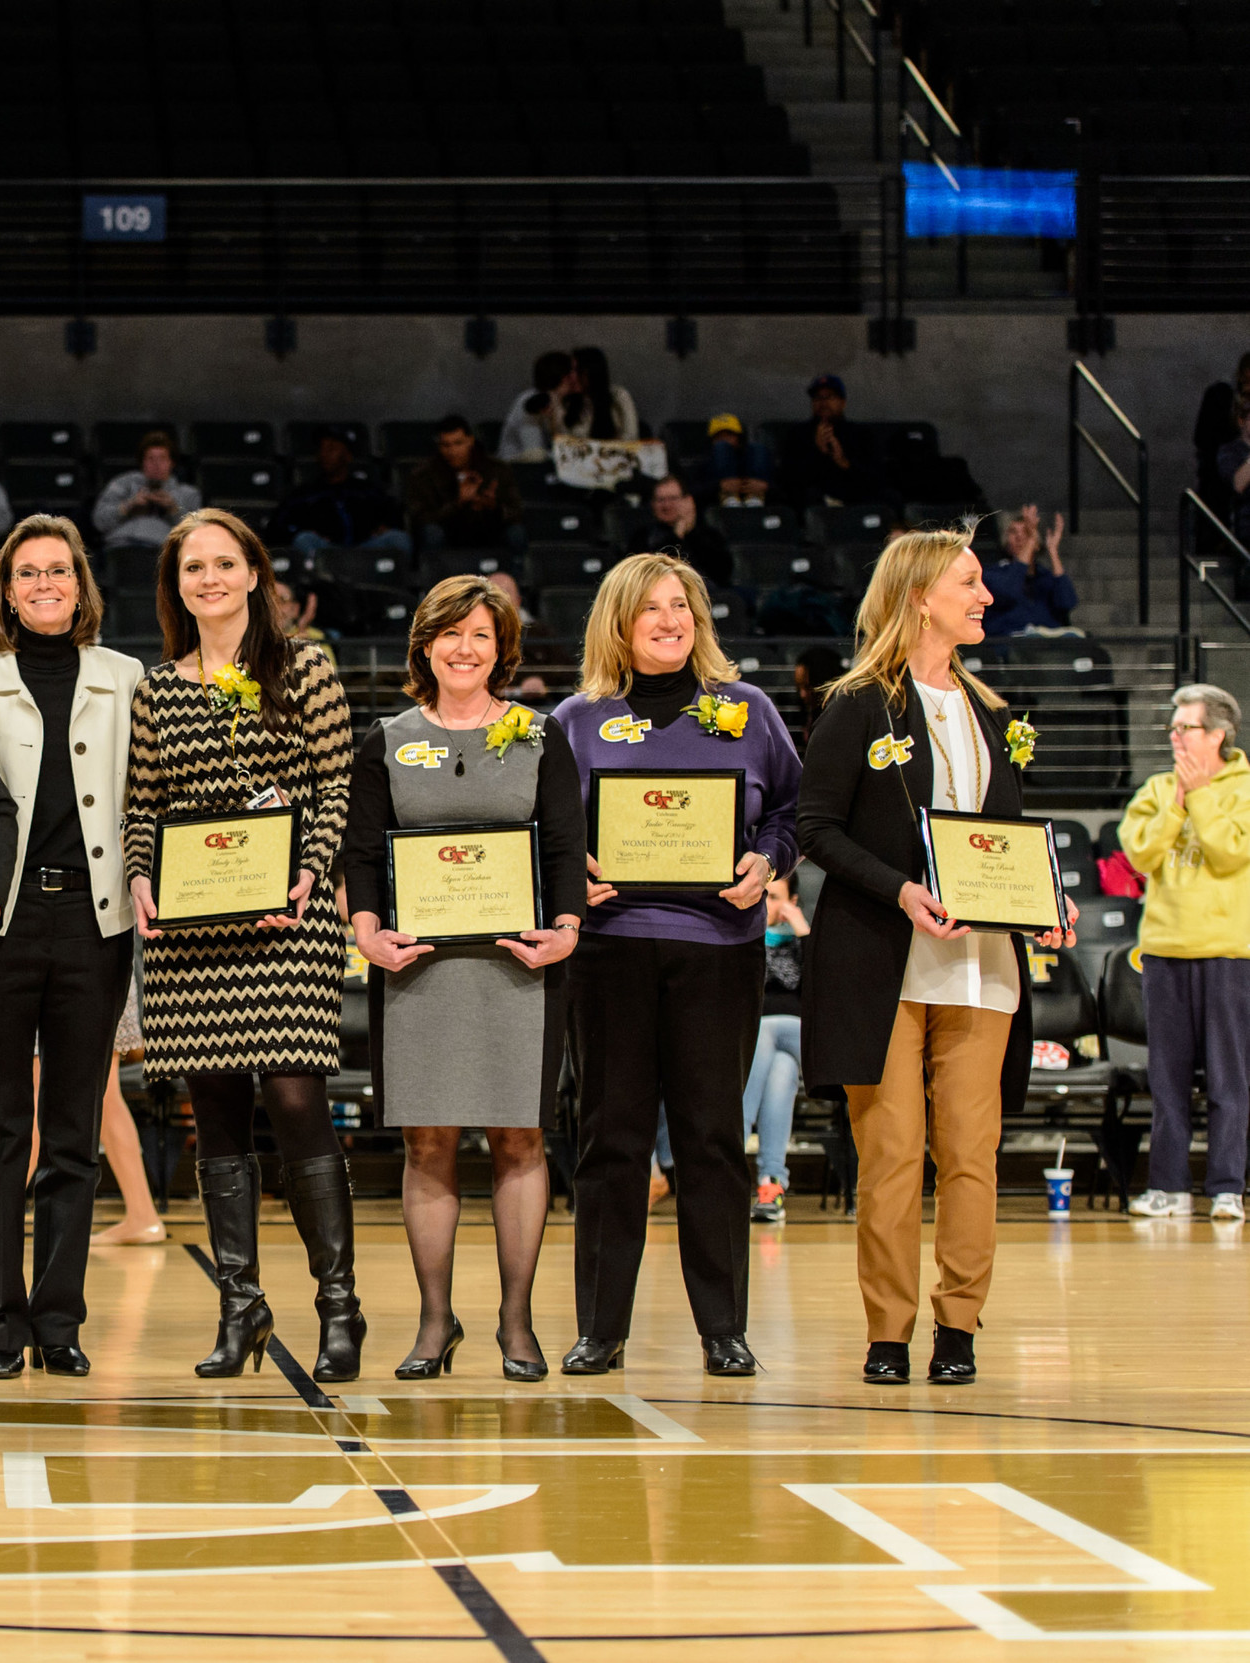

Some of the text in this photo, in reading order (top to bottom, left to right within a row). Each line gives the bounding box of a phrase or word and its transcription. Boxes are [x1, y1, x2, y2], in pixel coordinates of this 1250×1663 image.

[98, 205, 151, 232] 109
[183, 878, 215, 887] WOMEN
[239, 872, 267, 881] FRONT
[957, 880, 1035, 892] WOMEN OUT FRONT
[419, 892, 509, 903] WOMEN OUT FRONT
